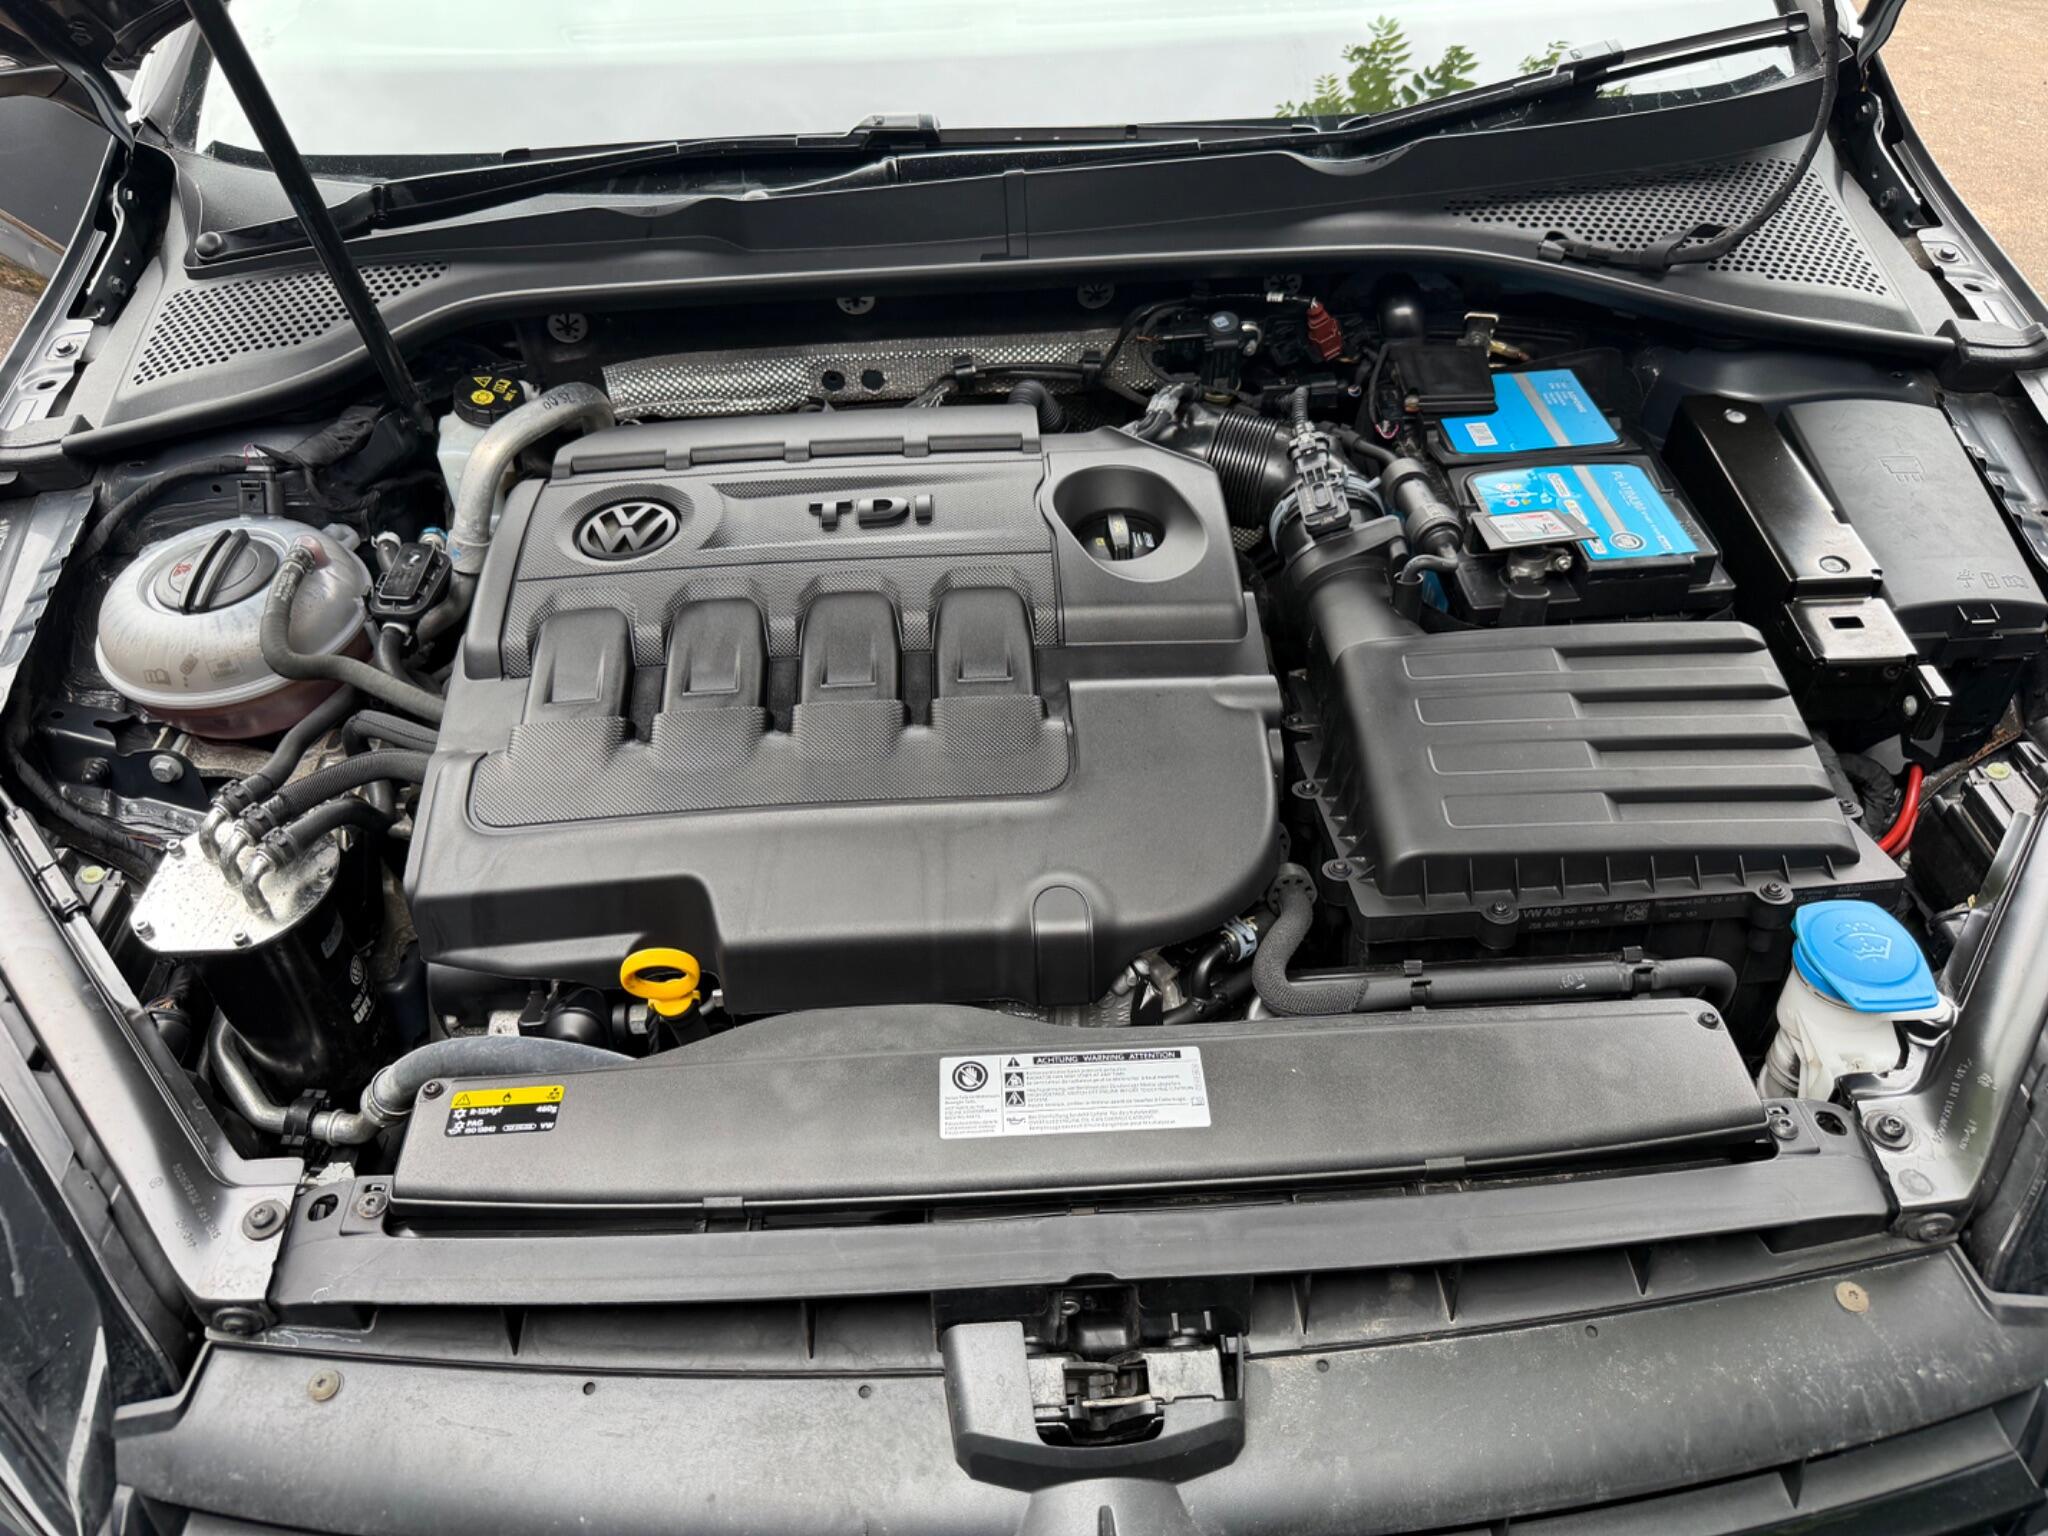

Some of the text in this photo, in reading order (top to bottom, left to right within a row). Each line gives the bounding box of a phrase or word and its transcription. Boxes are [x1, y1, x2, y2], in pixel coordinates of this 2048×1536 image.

[808, 493, 934, 531] TDI
[1036, 1051, 1177, 1065] ACHTUNG WARNING ATTENTION
